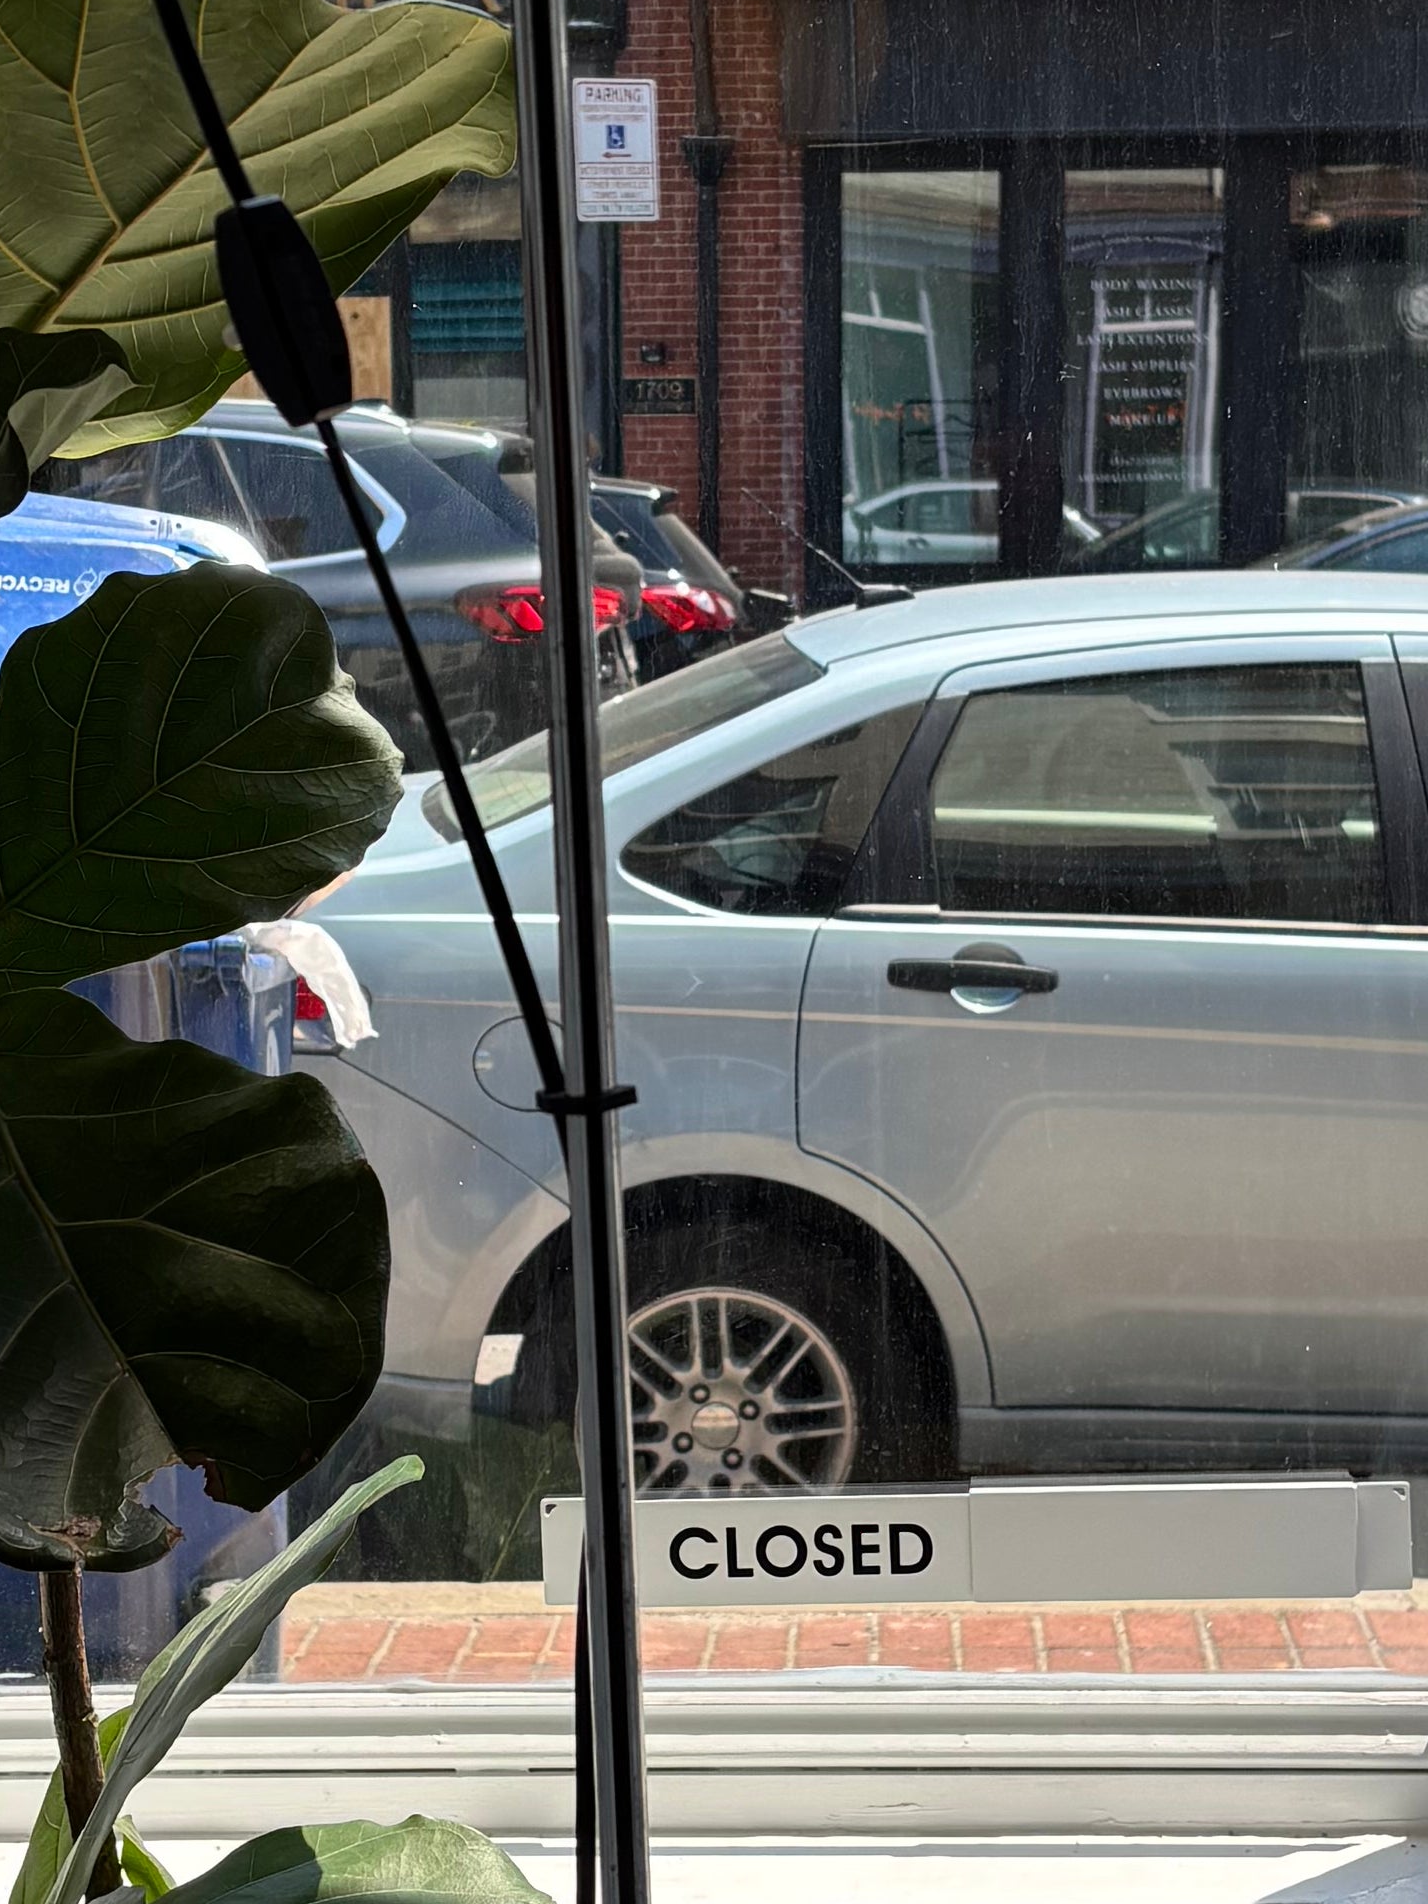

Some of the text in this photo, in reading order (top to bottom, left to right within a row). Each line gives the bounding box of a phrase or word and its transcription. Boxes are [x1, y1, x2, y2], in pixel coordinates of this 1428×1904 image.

[585, 87, 643, 103] PARKING
[636, 381, 685, 401] 1709
[667, 1521, 935, 1581] CLOSED
